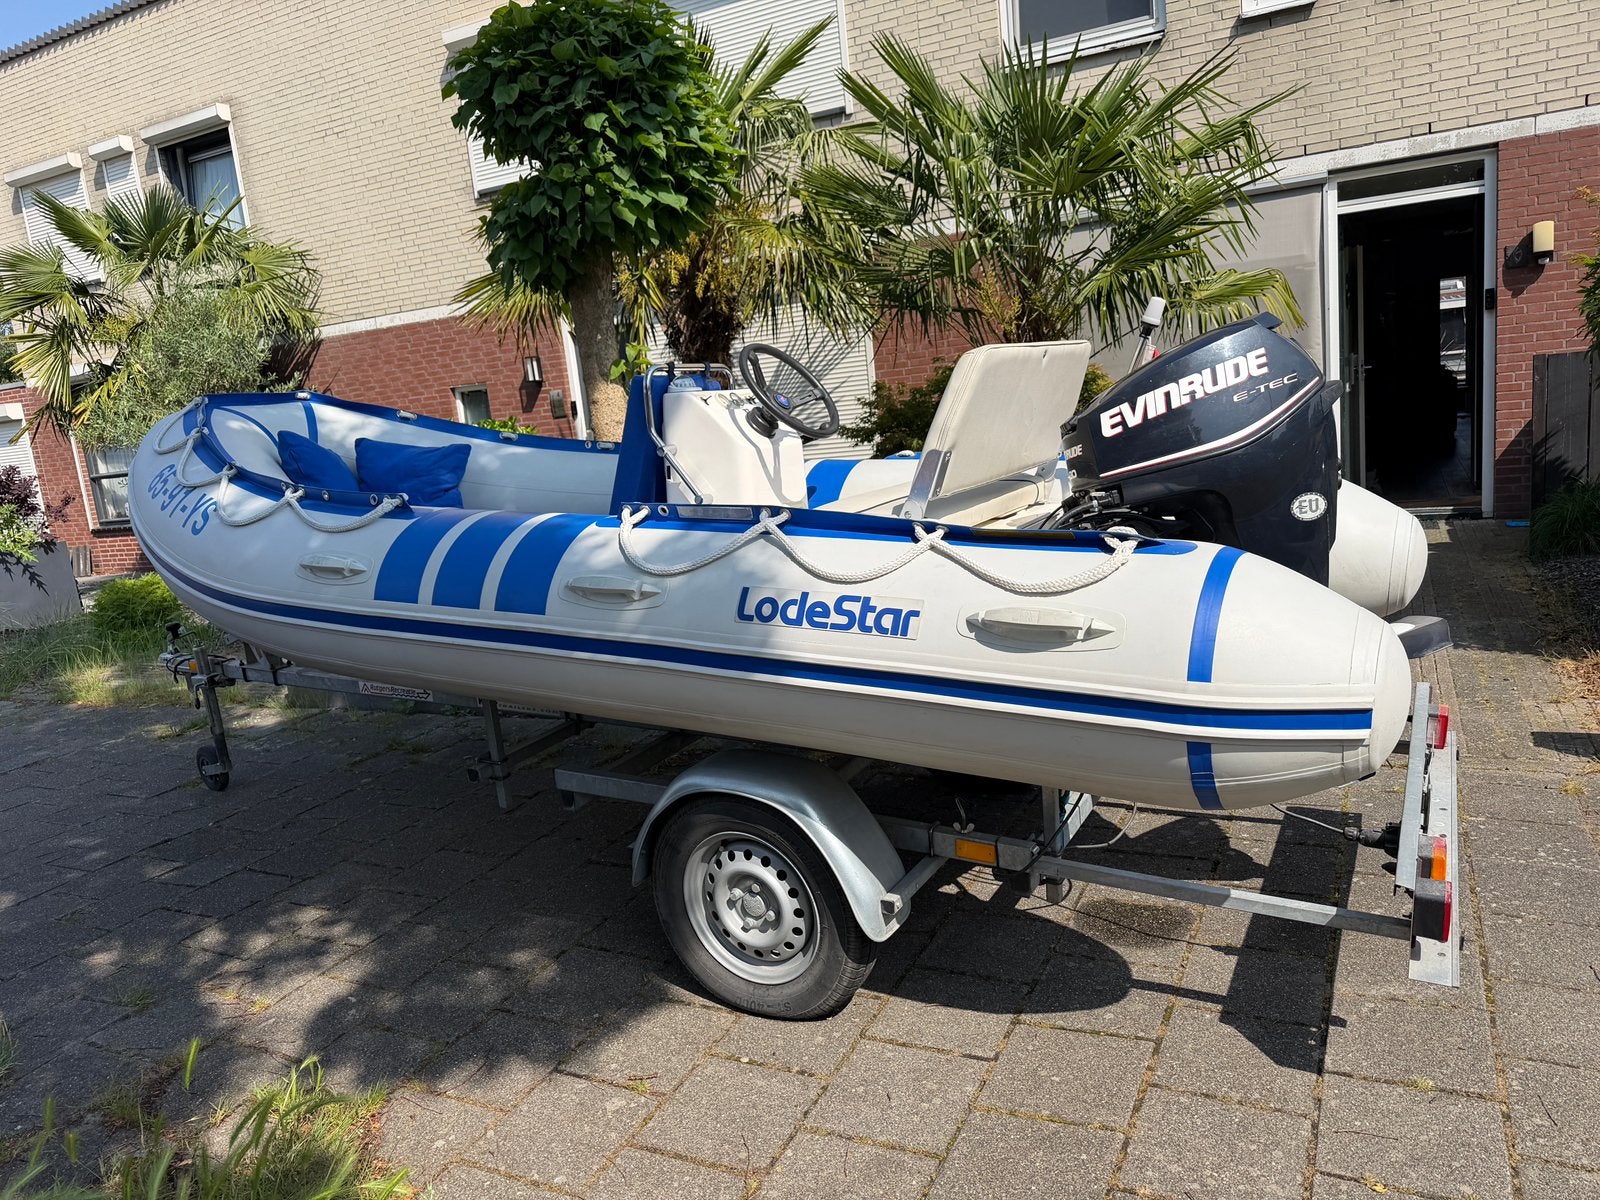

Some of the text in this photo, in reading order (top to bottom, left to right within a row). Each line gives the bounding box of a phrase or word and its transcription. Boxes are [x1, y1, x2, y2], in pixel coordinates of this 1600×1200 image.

[1100, 347, 1269, 438] EVINRUDE
[1233, 372, 1298, 403] E-TEC
[1298, 497, 1320, 515] EU
[737, 586, 921, 637] LodeStar
